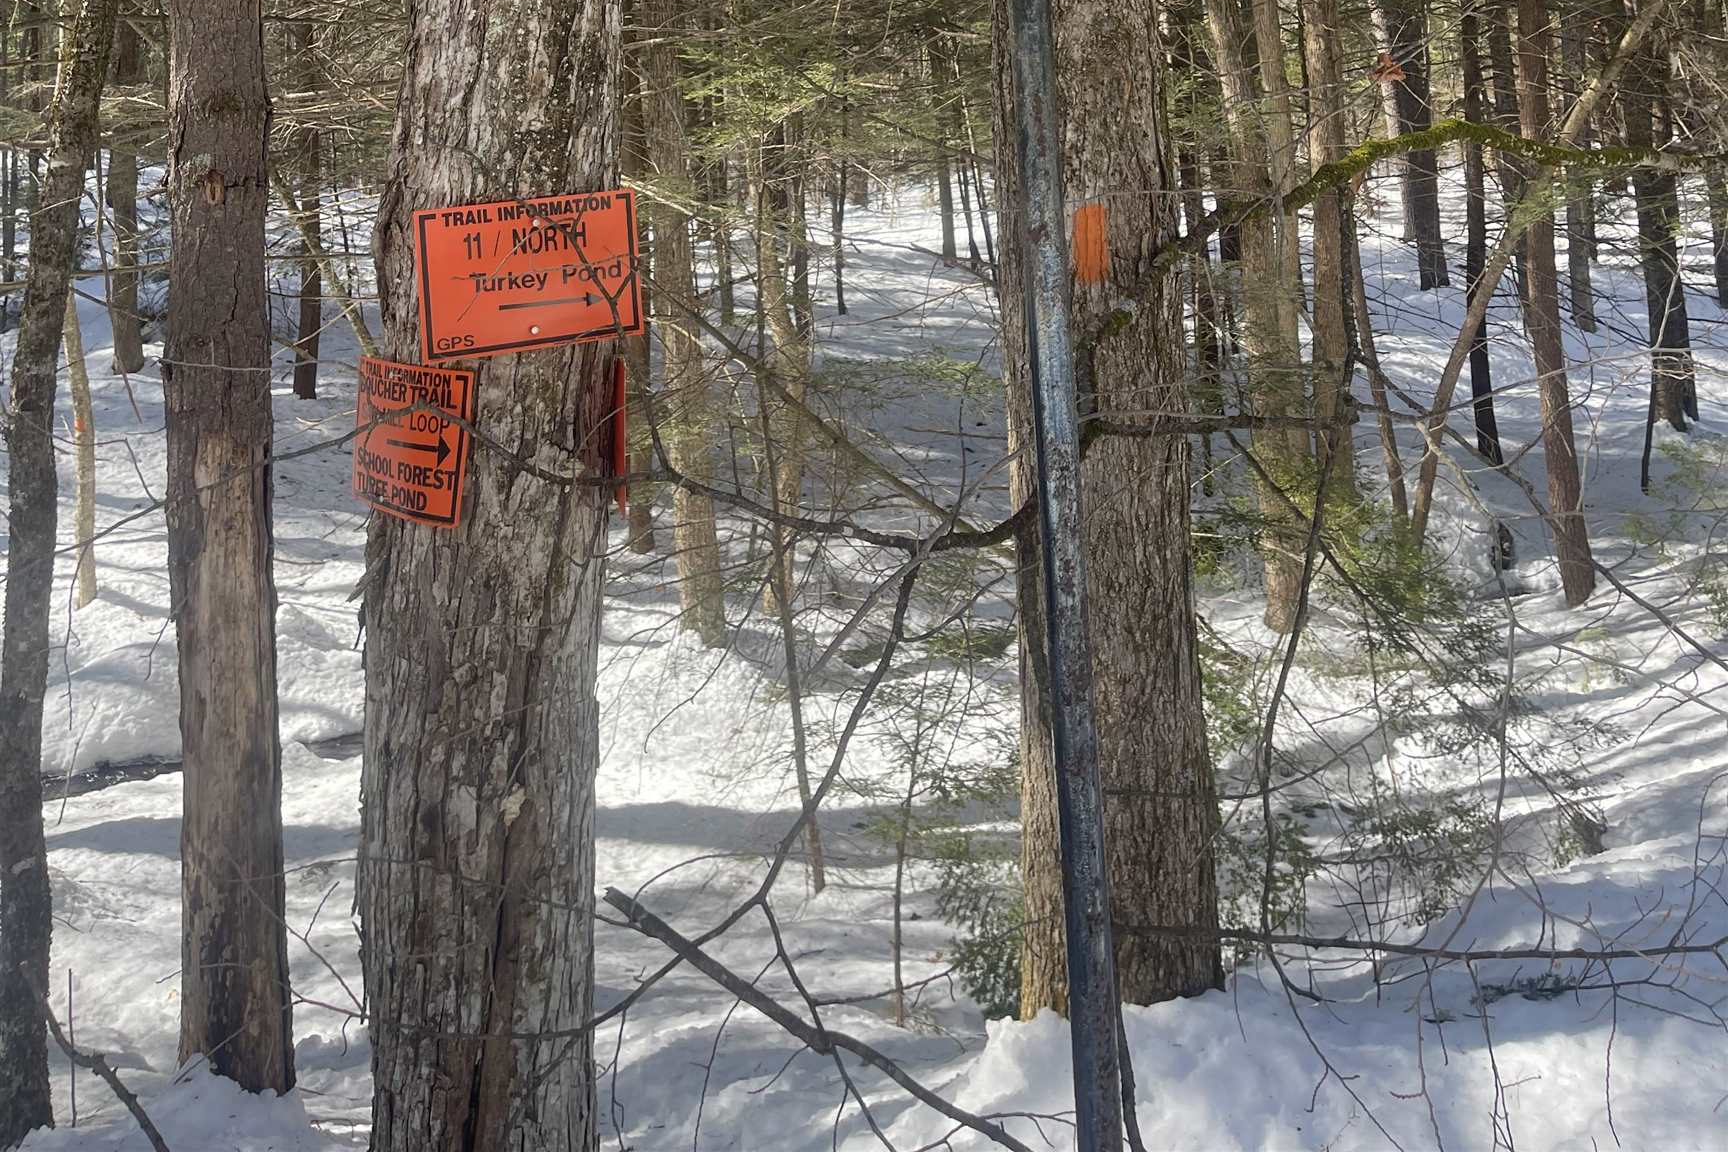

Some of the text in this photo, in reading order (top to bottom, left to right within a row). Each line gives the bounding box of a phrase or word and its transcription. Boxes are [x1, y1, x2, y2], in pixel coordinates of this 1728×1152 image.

[442, 195, 612, 228] TRAIL INFORMATION
[463, 232, 482, 260] 11
[512, 222, 587, 256] NORTH
[469, 259, 622, 294] Turkey Pond
[436, 335, 475, 351] GPS
[366, 361, 451, 389] TRAIL INFORMATION
[410, 385, 457, 409] TRAIL
[410, 412, 450, 435] LOOP
[357, 447, 456, 491] SCHOOL FOREST
[391, 484, 427, 511] POND
